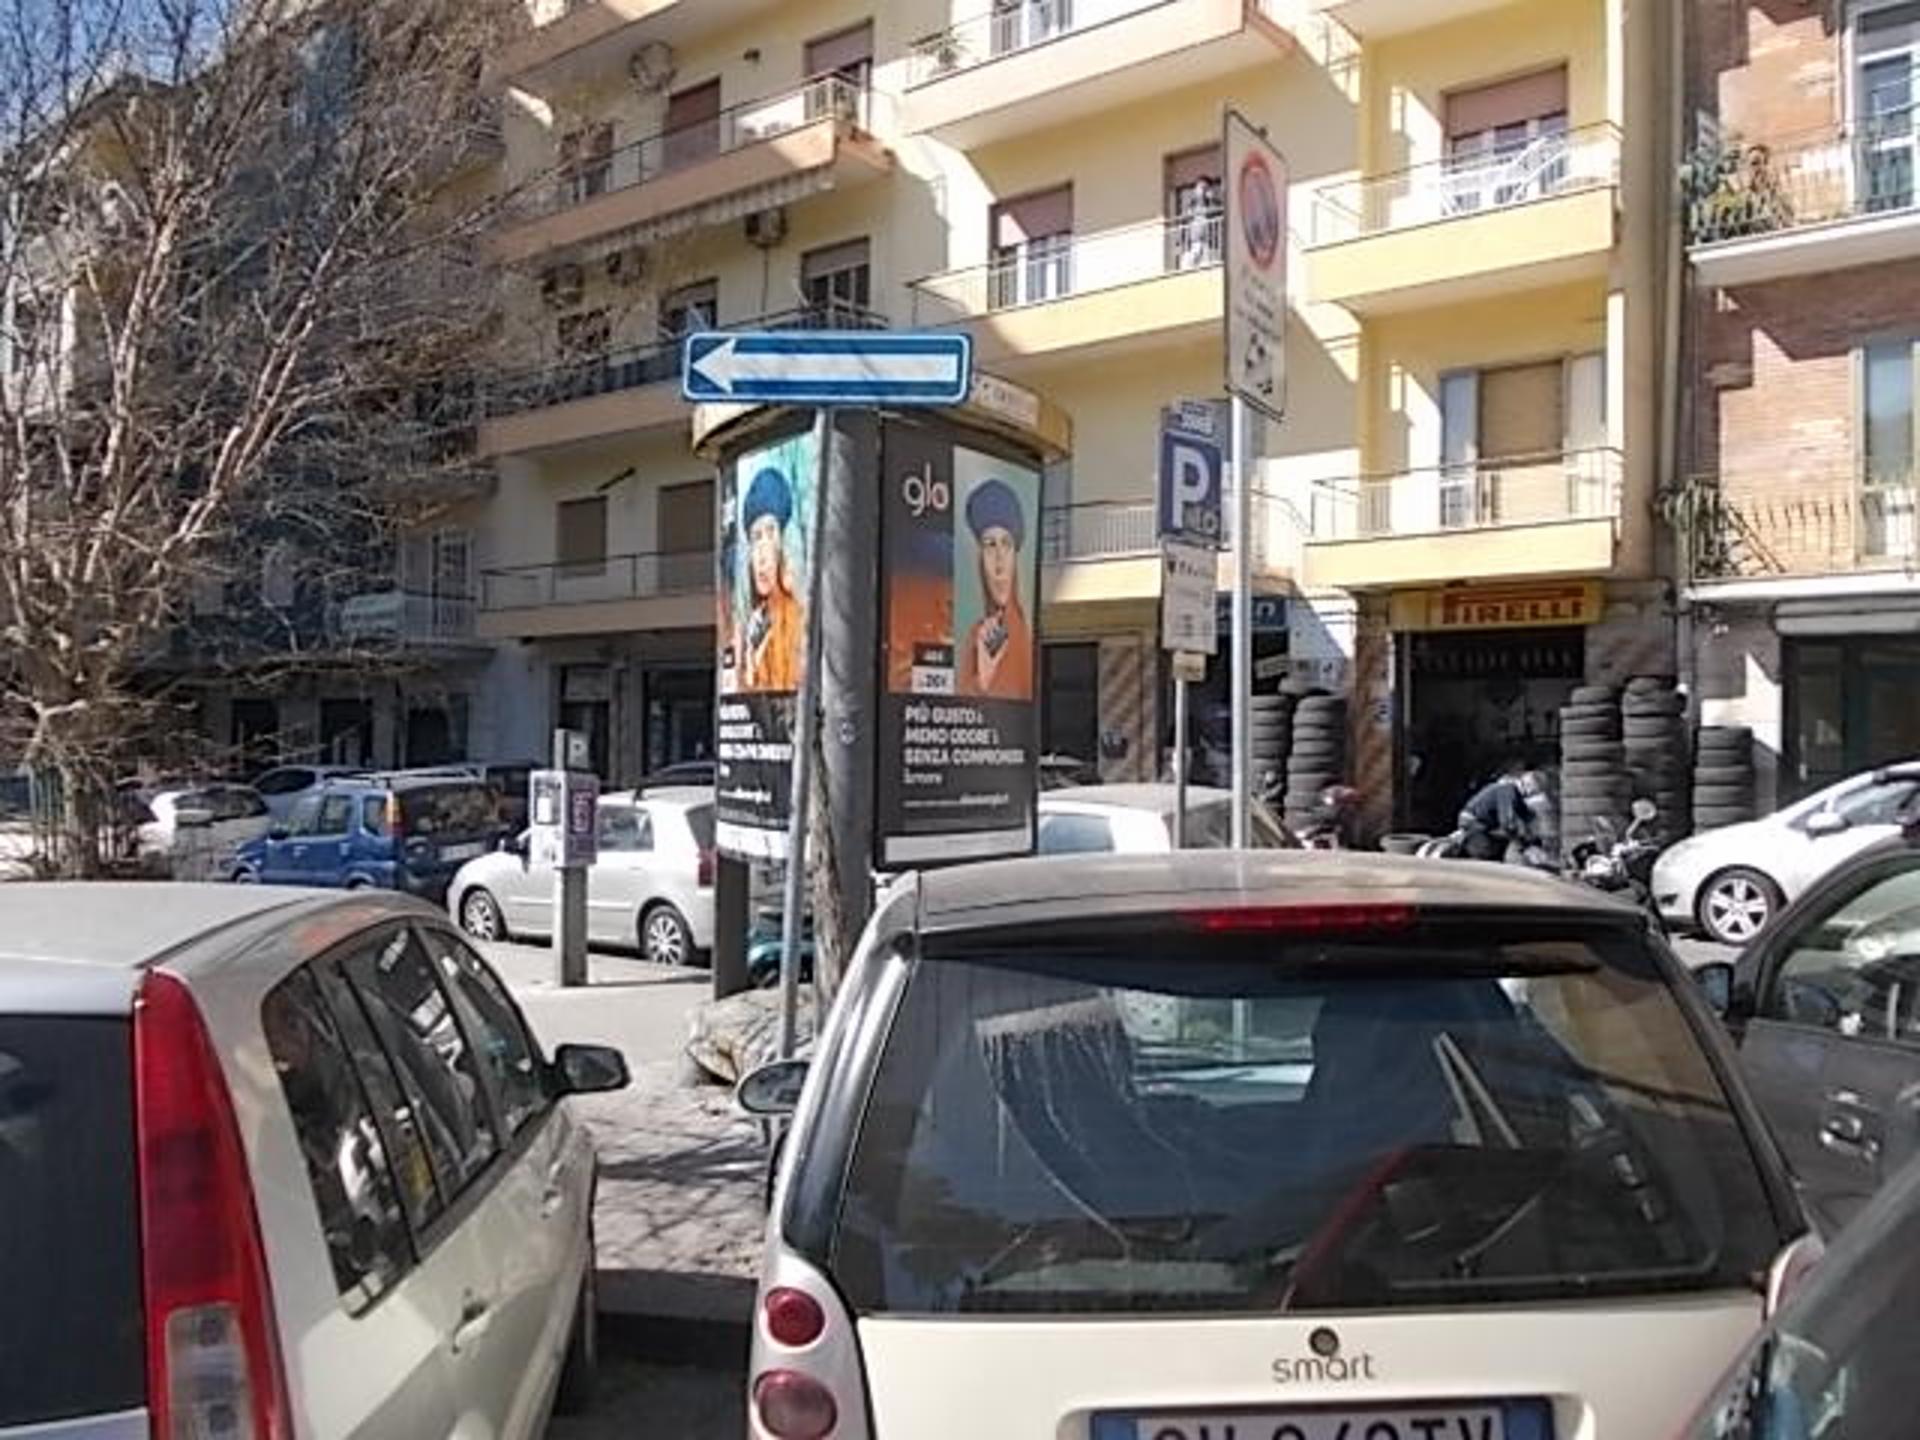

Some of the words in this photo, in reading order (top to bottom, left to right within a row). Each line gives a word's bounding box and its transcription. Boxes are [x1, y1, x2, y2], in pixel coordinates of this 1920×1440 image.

[902, 462, 949, 517] glo
[1172, 445, 1210, 529] P
[1441, 587, 1584, 625] PIRELLI
[1271, 1352, 1377, 1383] smart
